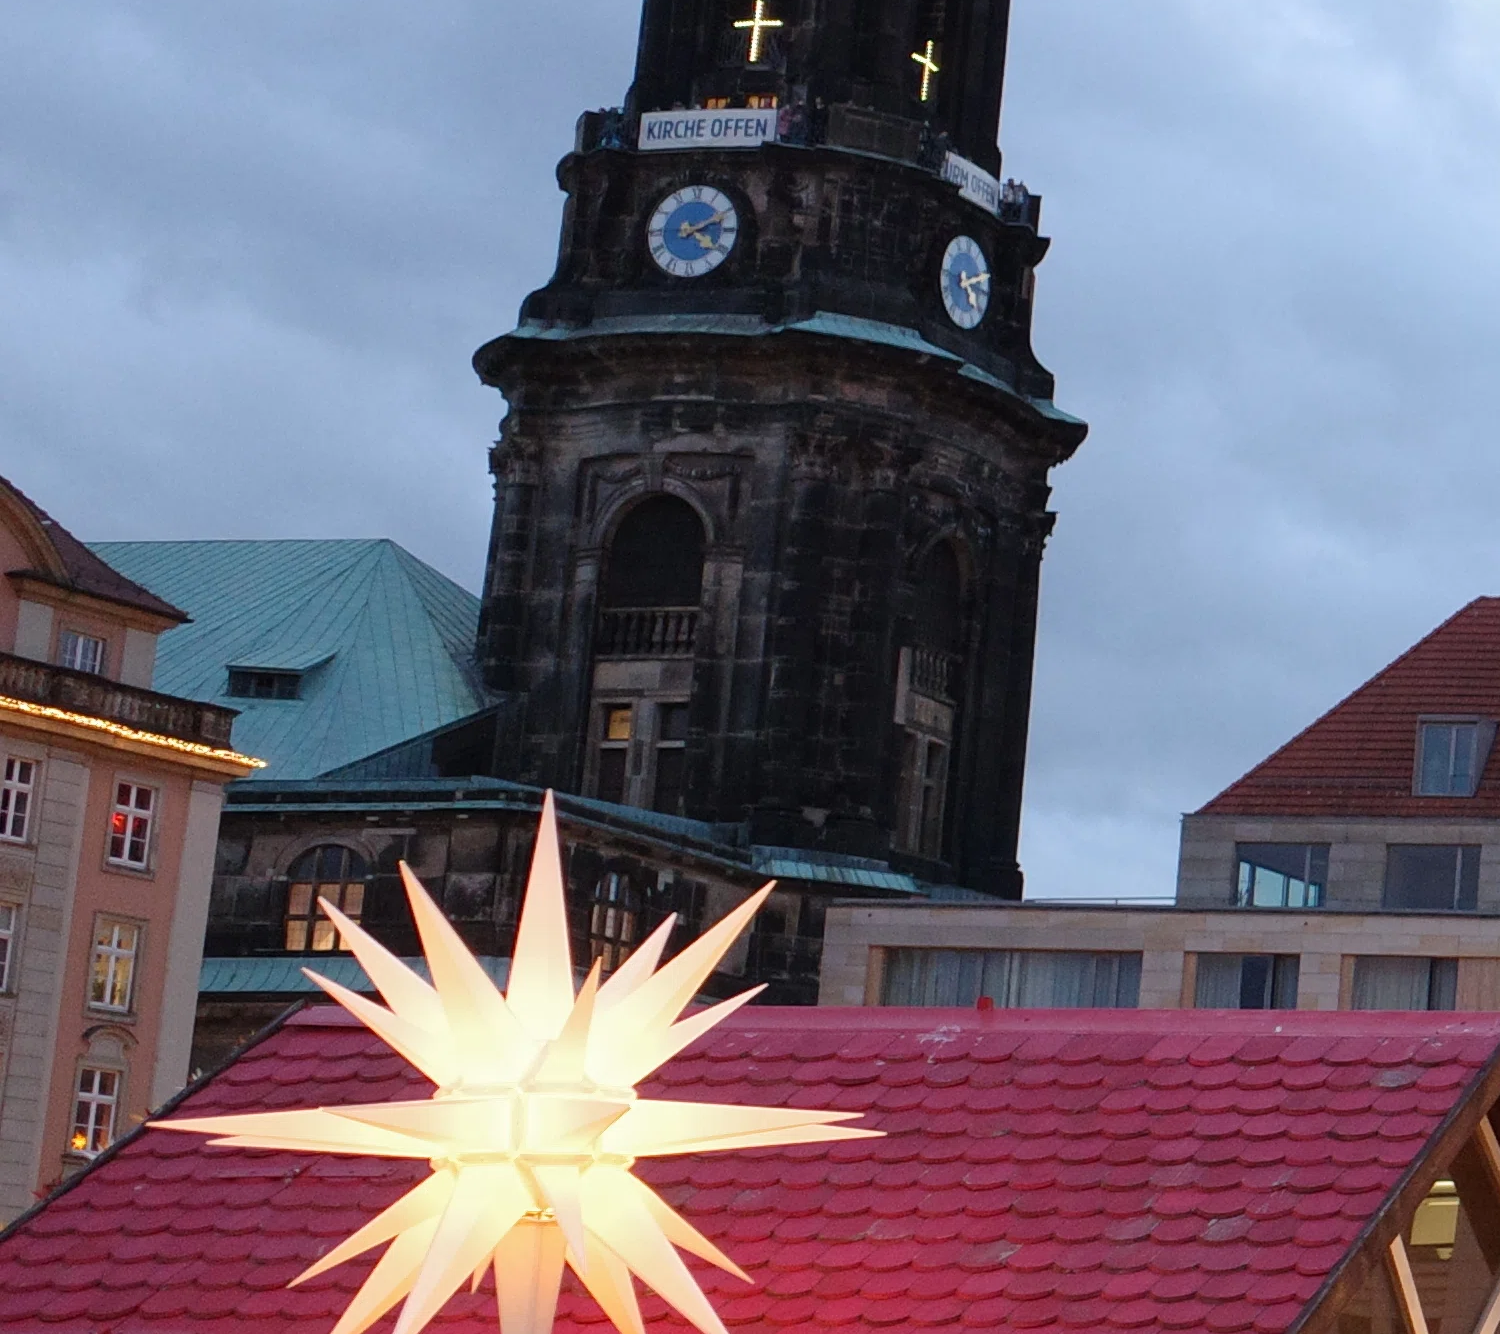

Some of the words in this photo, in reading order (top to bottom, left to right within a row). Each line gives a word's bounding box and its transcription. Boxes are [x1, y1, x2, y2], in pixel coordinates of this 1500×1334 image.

[646, 119, 706, 140] KIRCHE
[711, 118, 768, 138] OFFEN
[943, 161, 969, 191] URM
[971, 174, 995, 205] OFFEN
